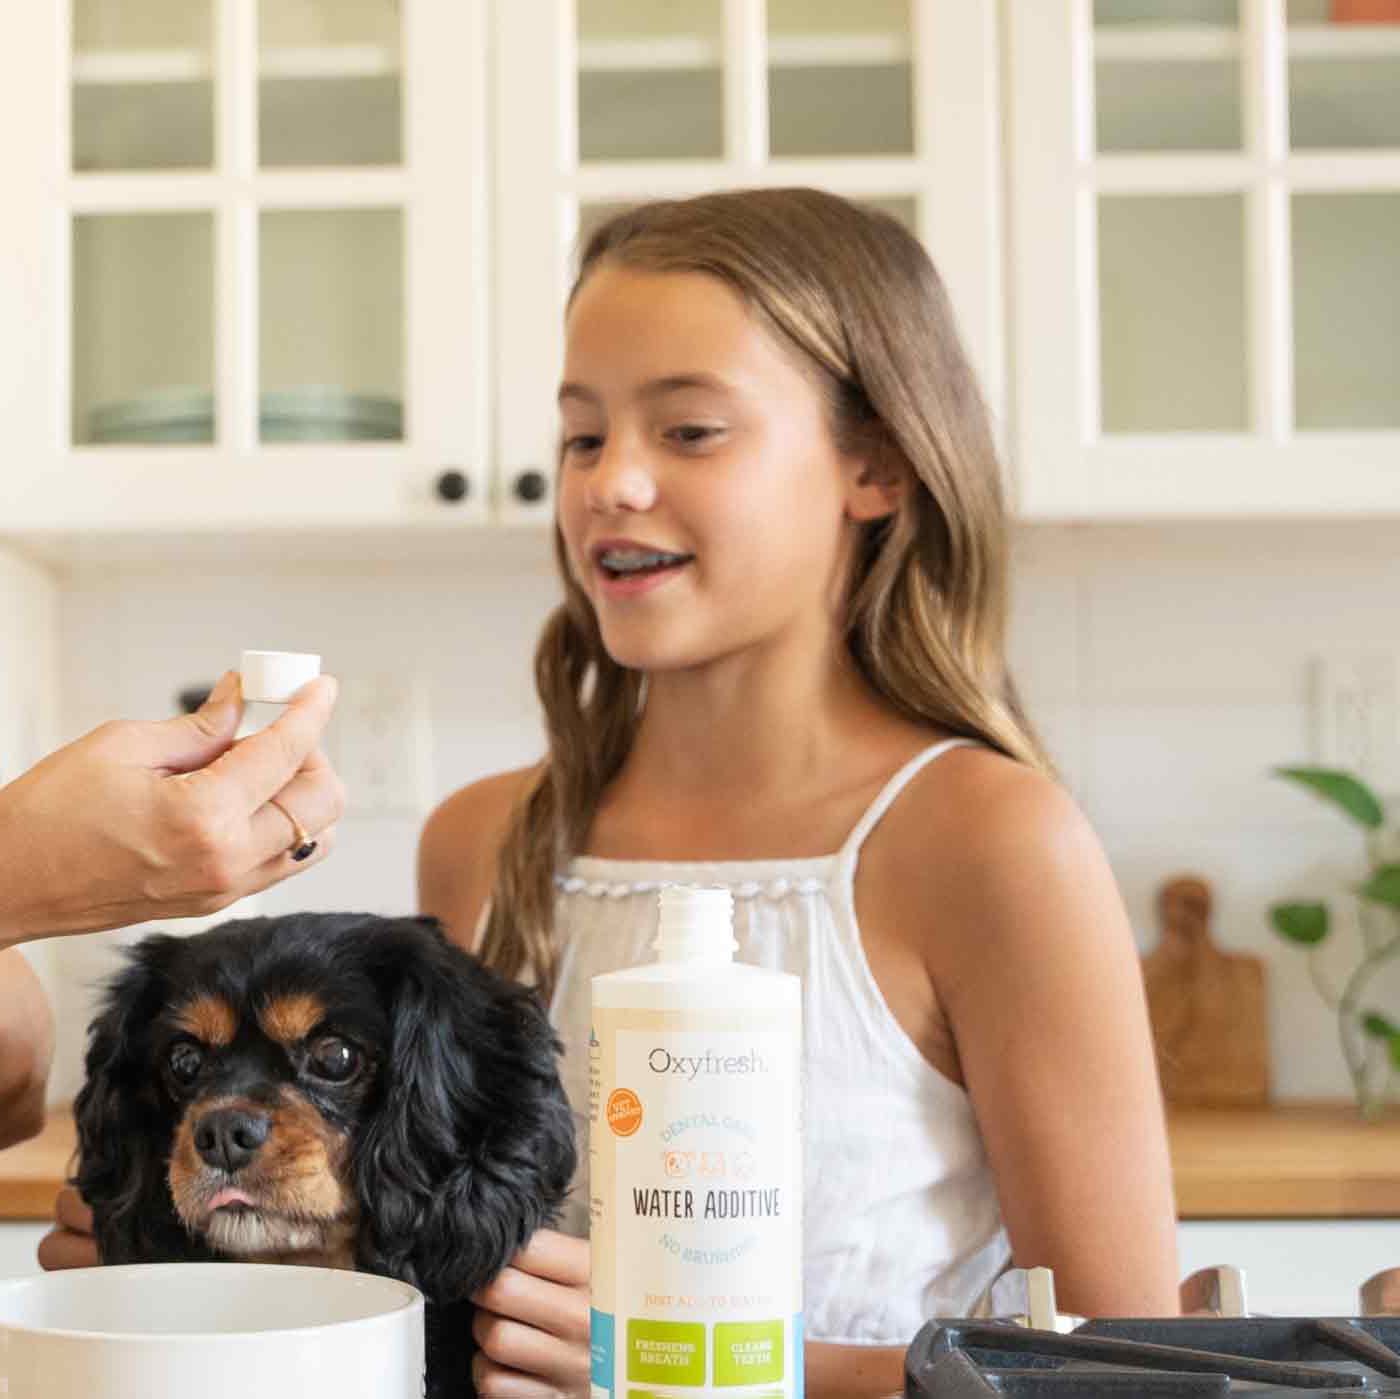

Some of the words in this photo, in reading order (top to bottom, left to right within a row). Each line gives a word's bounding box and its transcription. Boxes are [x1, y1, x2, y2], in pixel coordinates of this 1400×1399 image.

[632, 1186, 695, 1219] WATER
[704, 1186, 782, 1219] ADDITIVE
[658, 1233, 681, 1255] NO
[639, 1351, 690, 1366] BREATH
